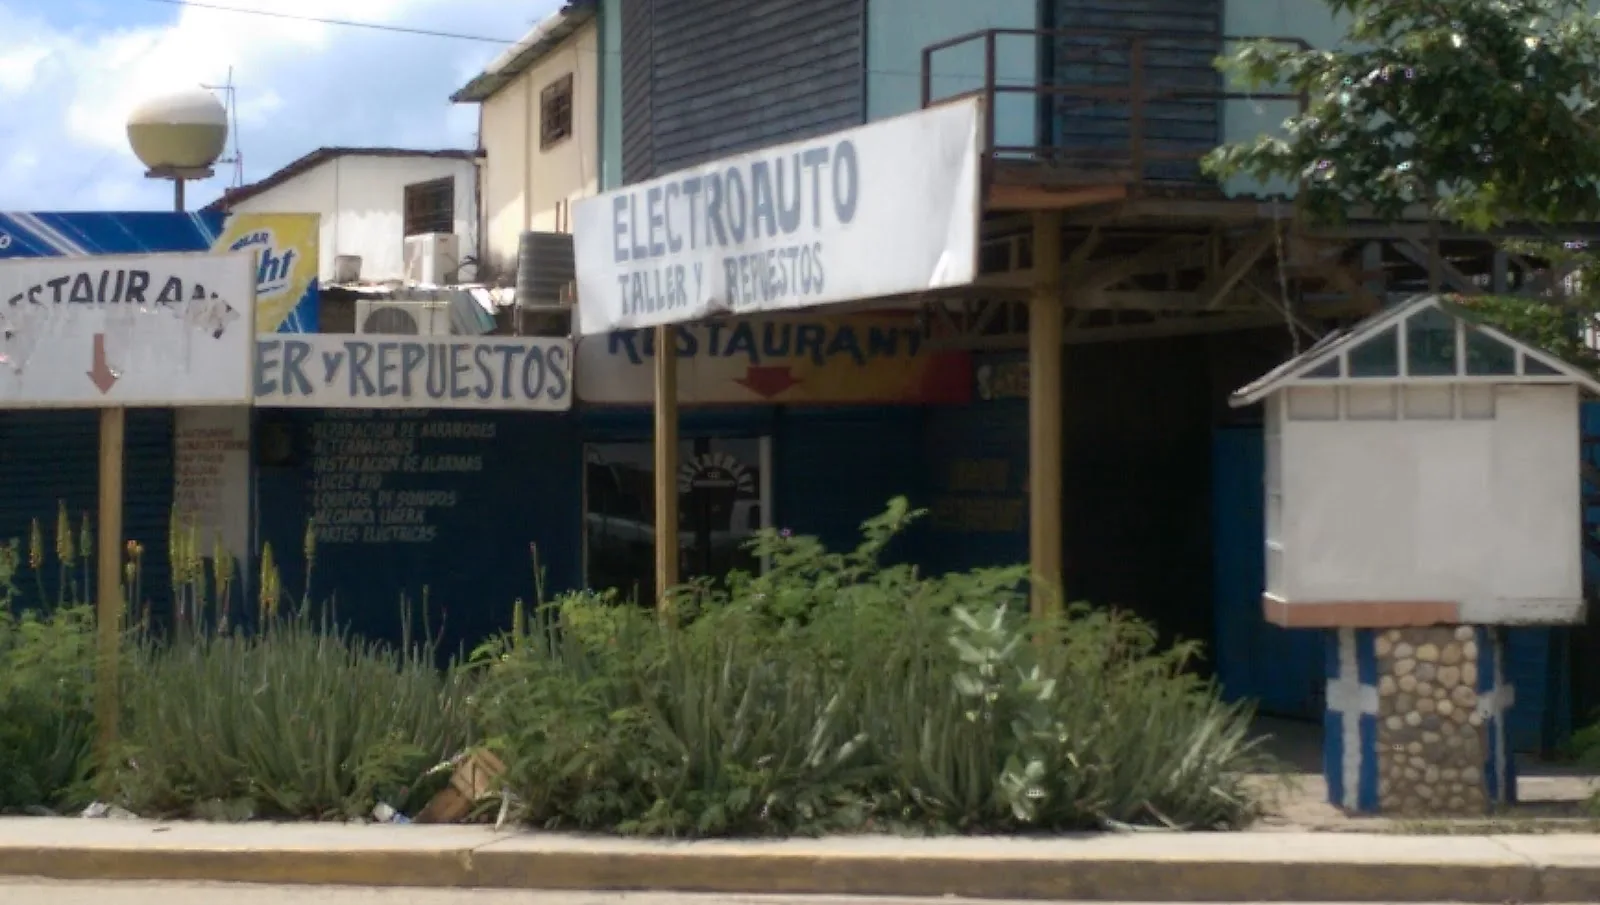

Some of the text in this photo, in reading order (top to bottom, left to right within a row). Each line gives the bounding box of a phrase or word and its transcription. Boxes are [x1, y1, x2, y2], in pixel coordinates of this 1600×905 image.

[613, 139, 859, 263] ELECTROAUTO
[617, 240, 824, 316] TALLER Y REPUESTOS
[344, 341, 566, 400] REPUESTOS
